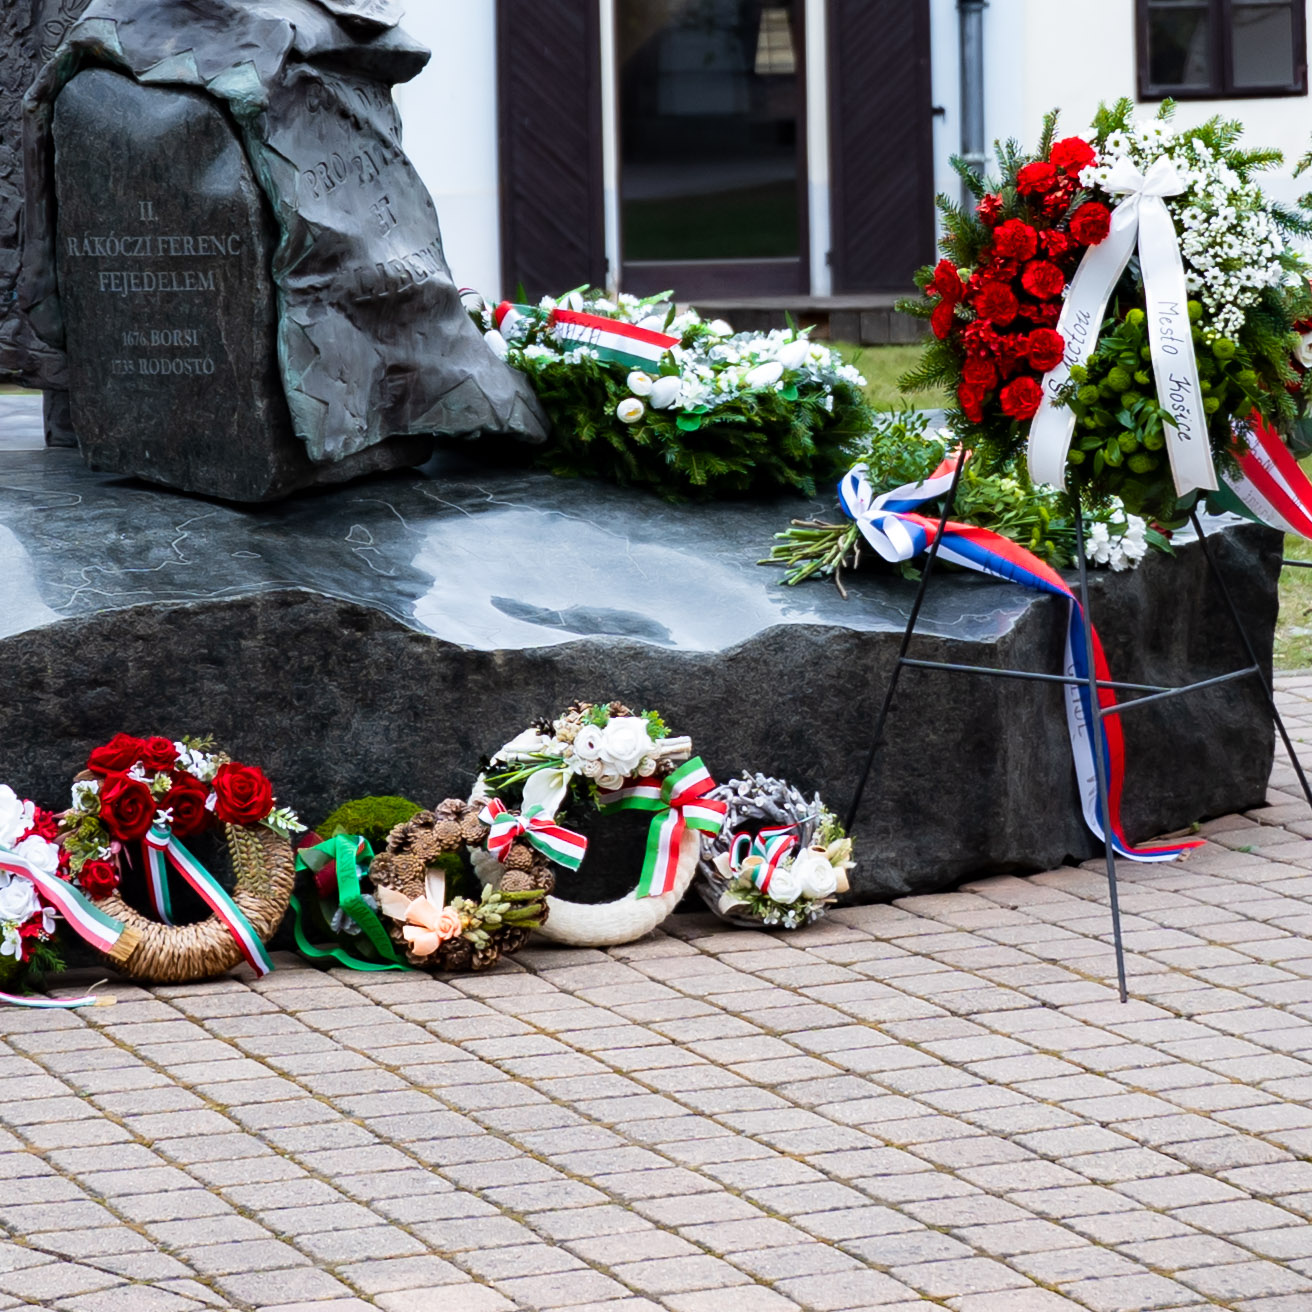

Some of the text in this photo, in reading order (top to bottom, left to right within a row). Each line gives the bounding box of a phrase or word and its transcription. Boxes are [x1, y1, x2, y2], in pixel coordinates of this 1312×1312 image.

[138, 200, 158, 221] II.
[66, 230, 241, 257] RÁKÓCZI FERENC
[98, 270, 216, 297] FEJEDELEM
[150, 329, 199, 347] BORSI
[138, 354, 215, 375] RODOSTÓ
[1157, 301, 1192, 442] Mesto Košice
